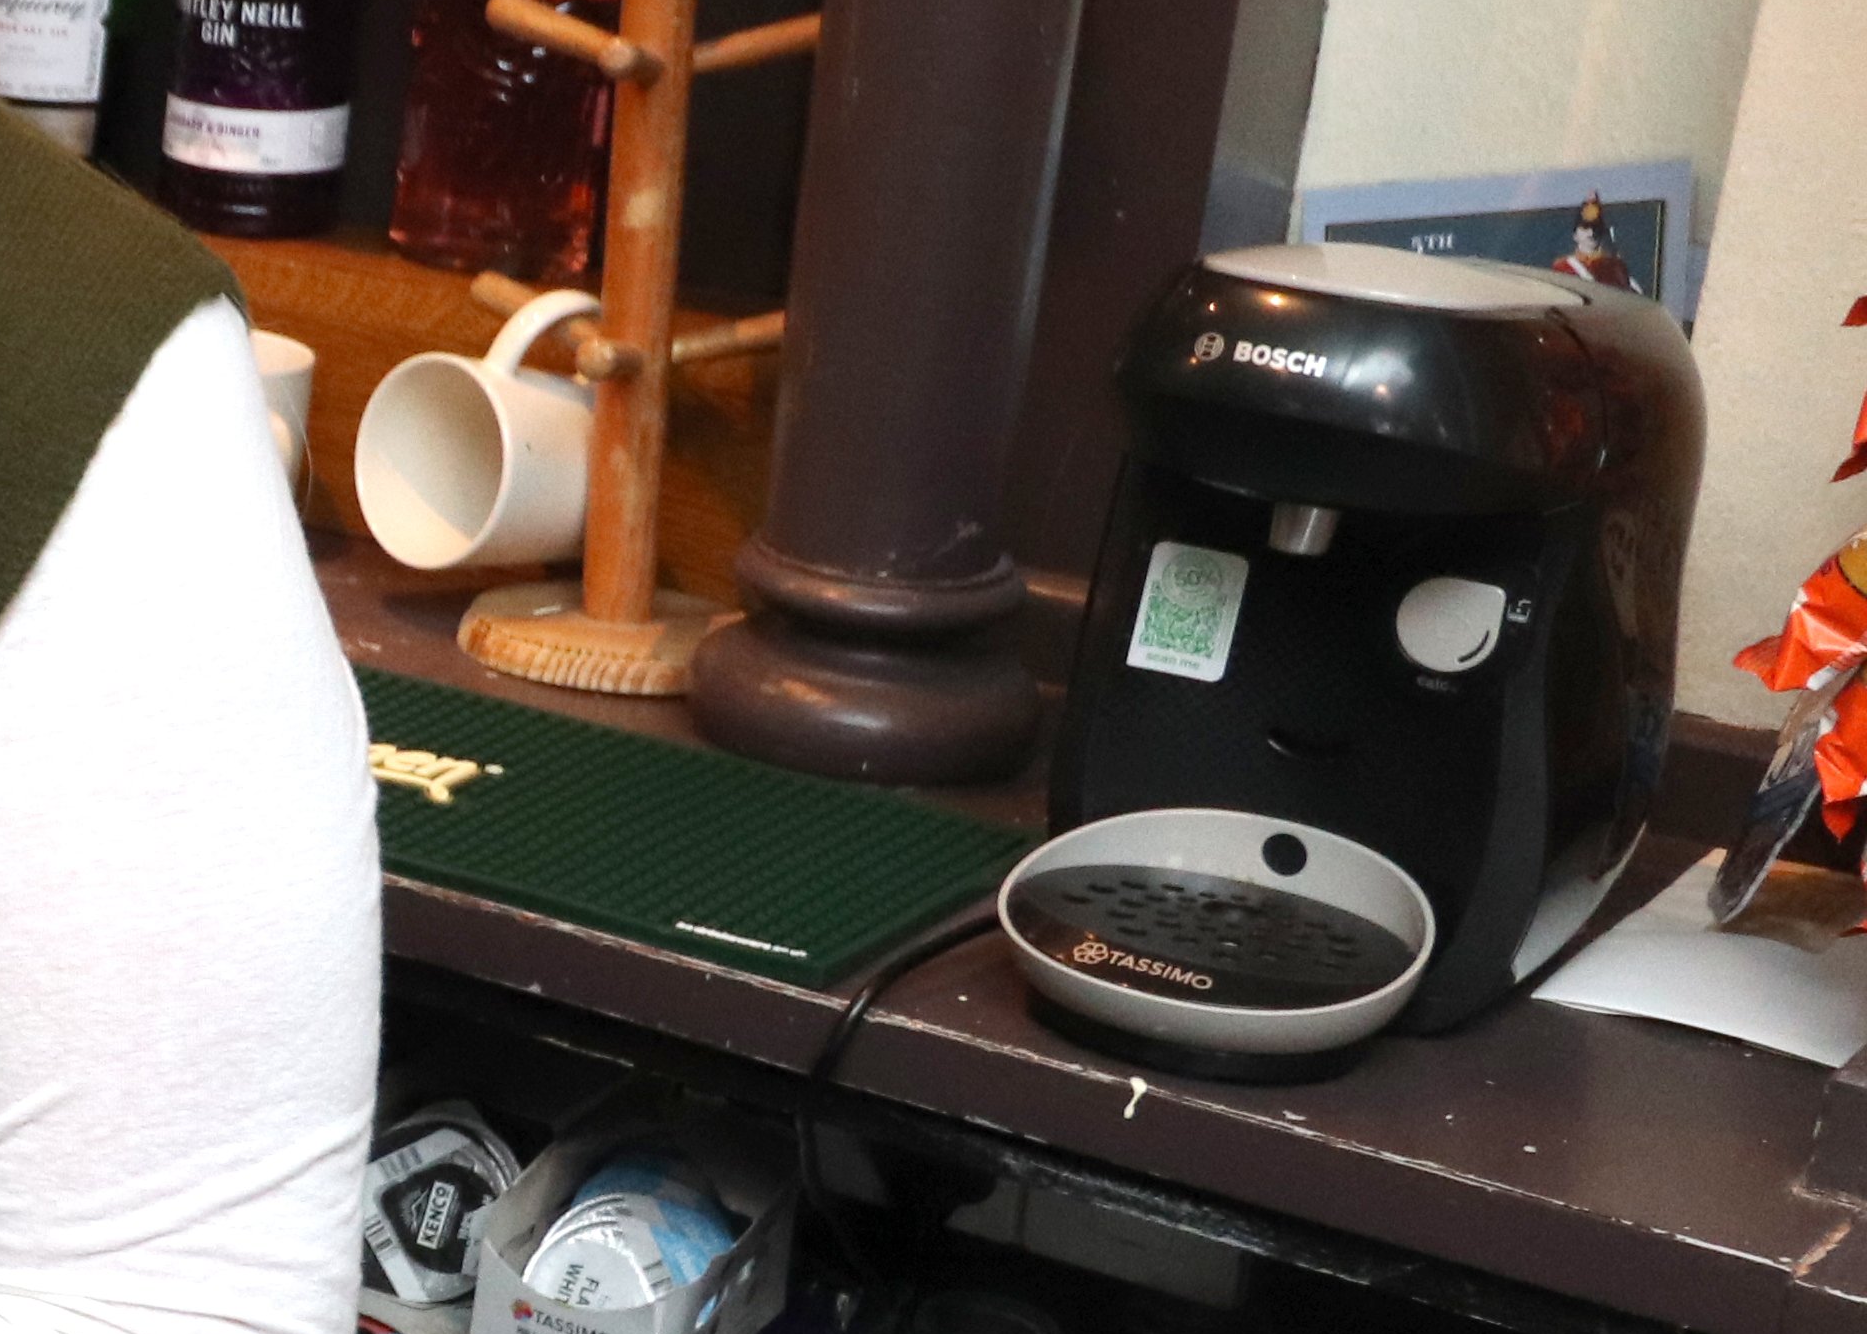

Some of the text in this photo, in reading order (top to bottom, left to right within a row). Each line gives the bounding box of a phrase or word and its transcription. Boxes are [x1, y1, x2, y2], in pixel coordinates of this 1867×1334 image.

[241, 0, 304, 29] NEILL
[201, 21, 237, 47] GIN
[1232, 341, 1328, 378] BOSCH
[1109, 950, 1213, 990] TASSIMO
[420, 1185, 448, 1244] KENCO
